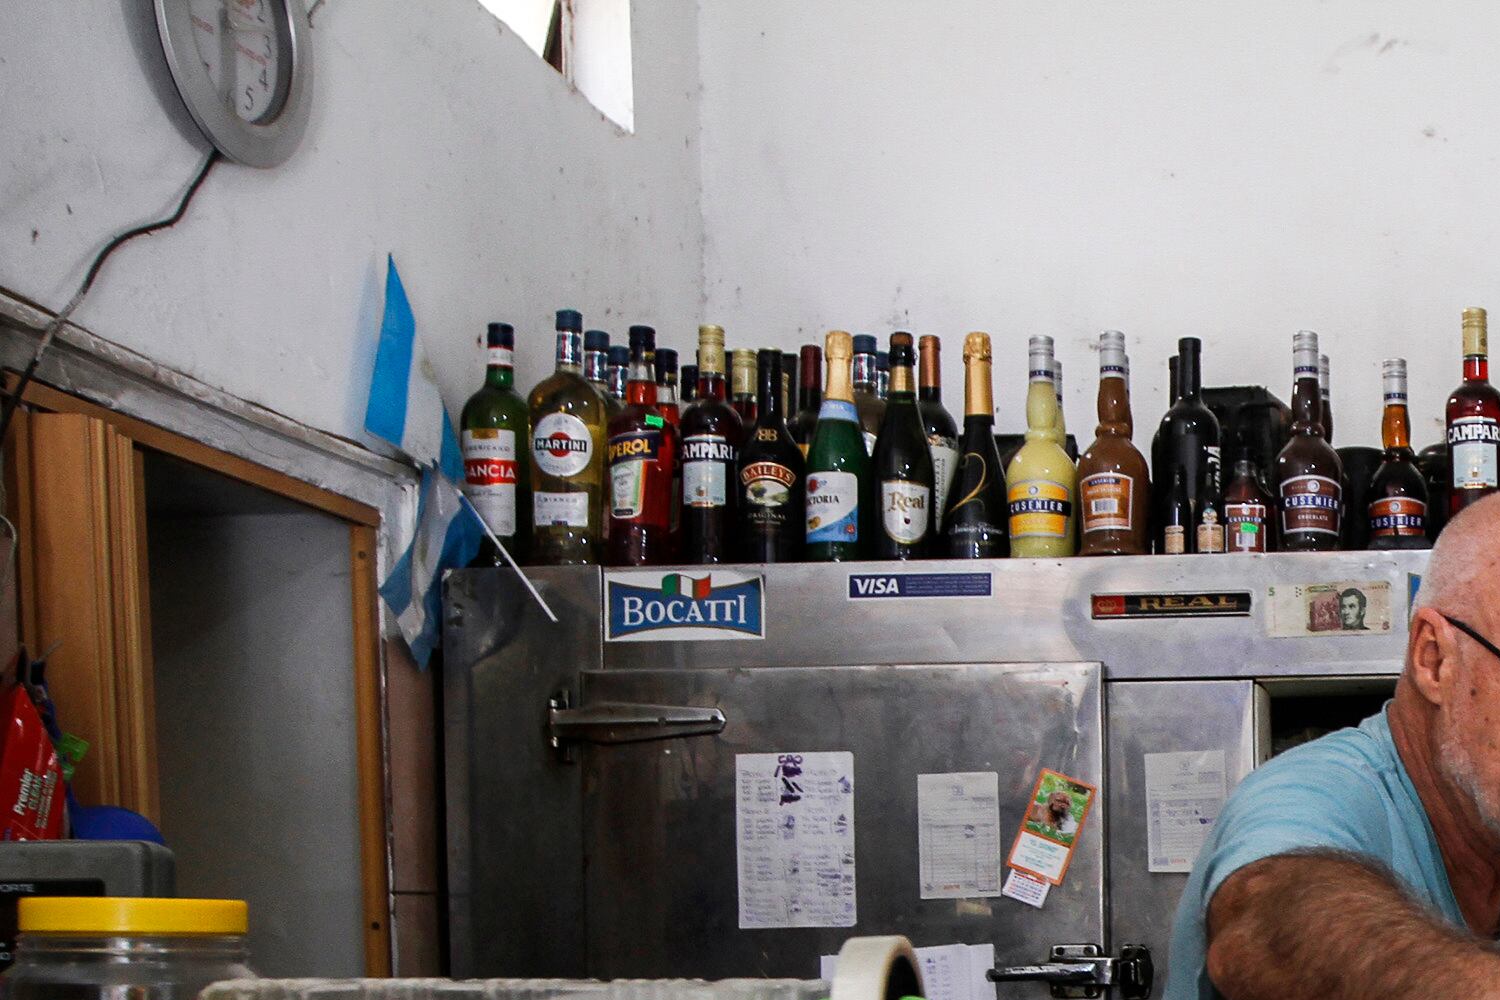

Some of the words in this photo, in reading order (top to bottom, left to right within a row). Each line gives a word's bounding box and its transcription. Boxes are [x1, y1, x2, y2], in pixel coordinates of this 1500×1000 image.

[535, 439, 587, 450] MARTINI
[742, 467, 793, 483] BAILEYS
[1010, 500, 1063, 513] CUSENIER
[1285, 496, 1338, 510] CUSENIER
[853, 577, 899, 595] VISA
[623, 594, 748, 626] BOCATTI
[1139, 594, 1238, 610] REAL
